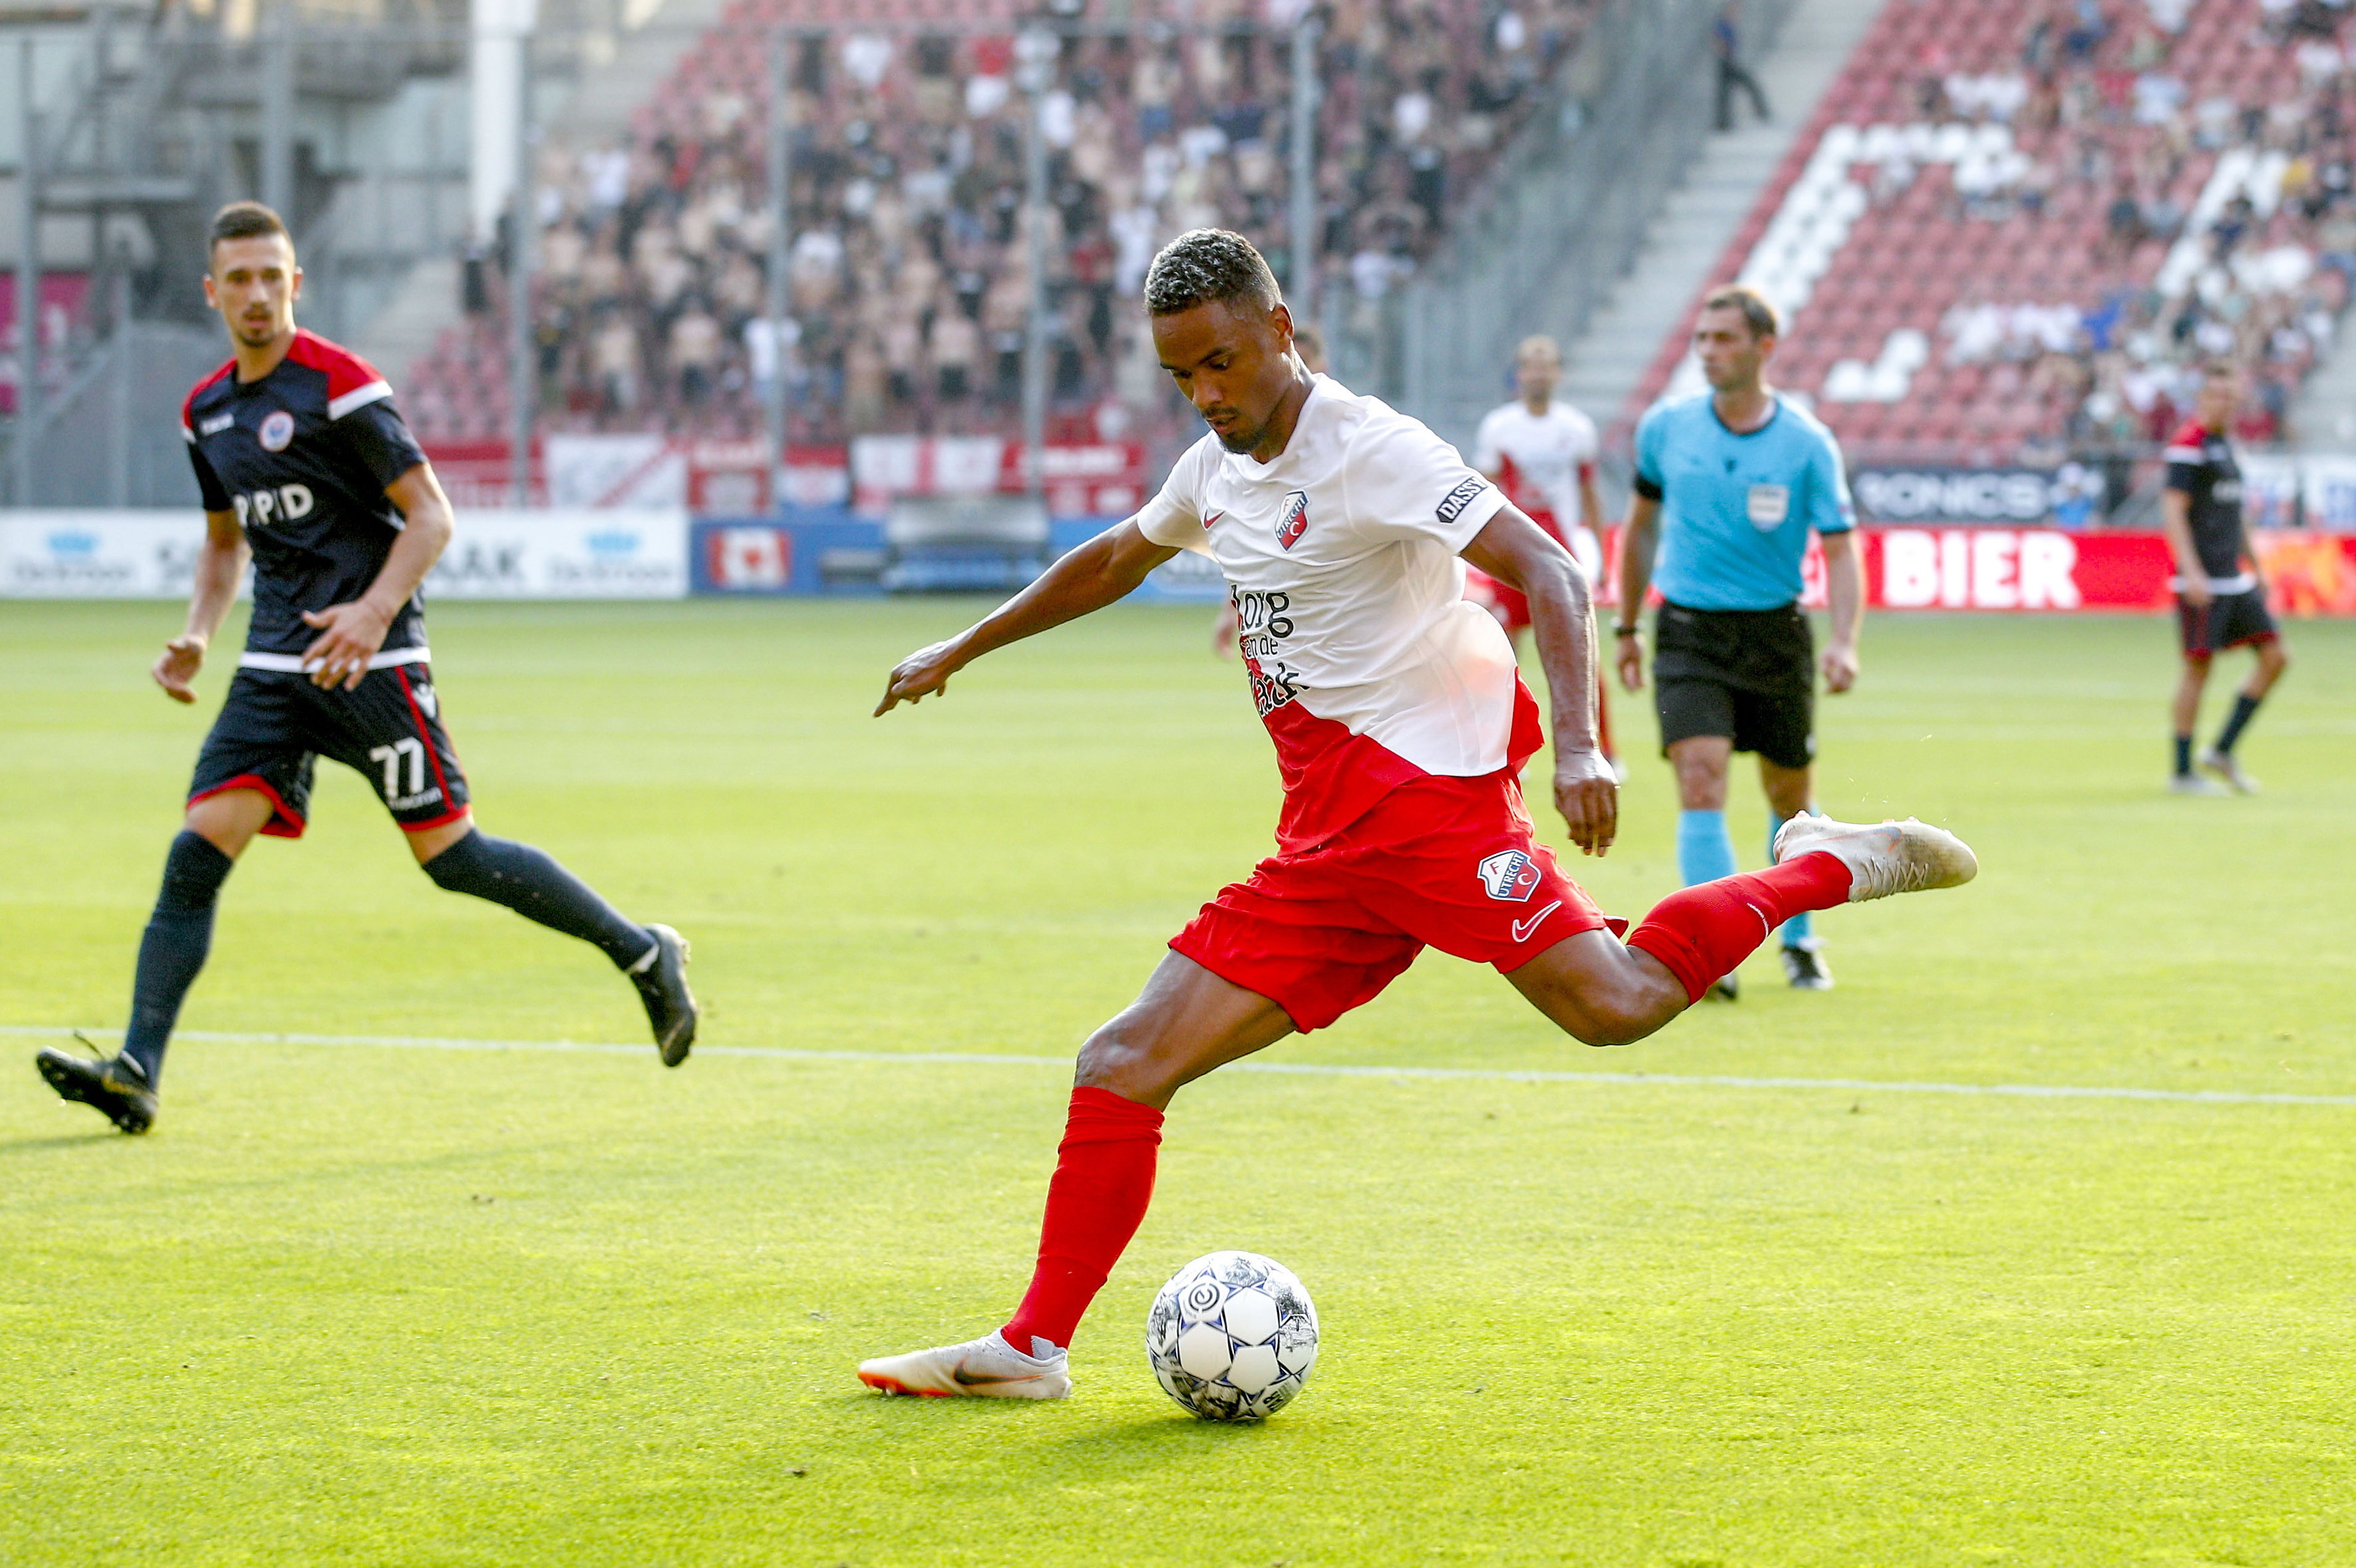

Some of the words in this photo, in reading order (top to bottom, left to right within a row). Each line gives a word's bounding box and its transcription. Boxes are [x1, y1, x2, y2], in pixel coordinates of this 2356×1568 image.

[1437, 476, 1487, 519] DASSY
[1884, 529, 2080, 608] BIER
[1259, 635, 1279, 656] de
[370, 736, 425, 797] 77
[1498, 852, 1525, 897] UTRECHT
